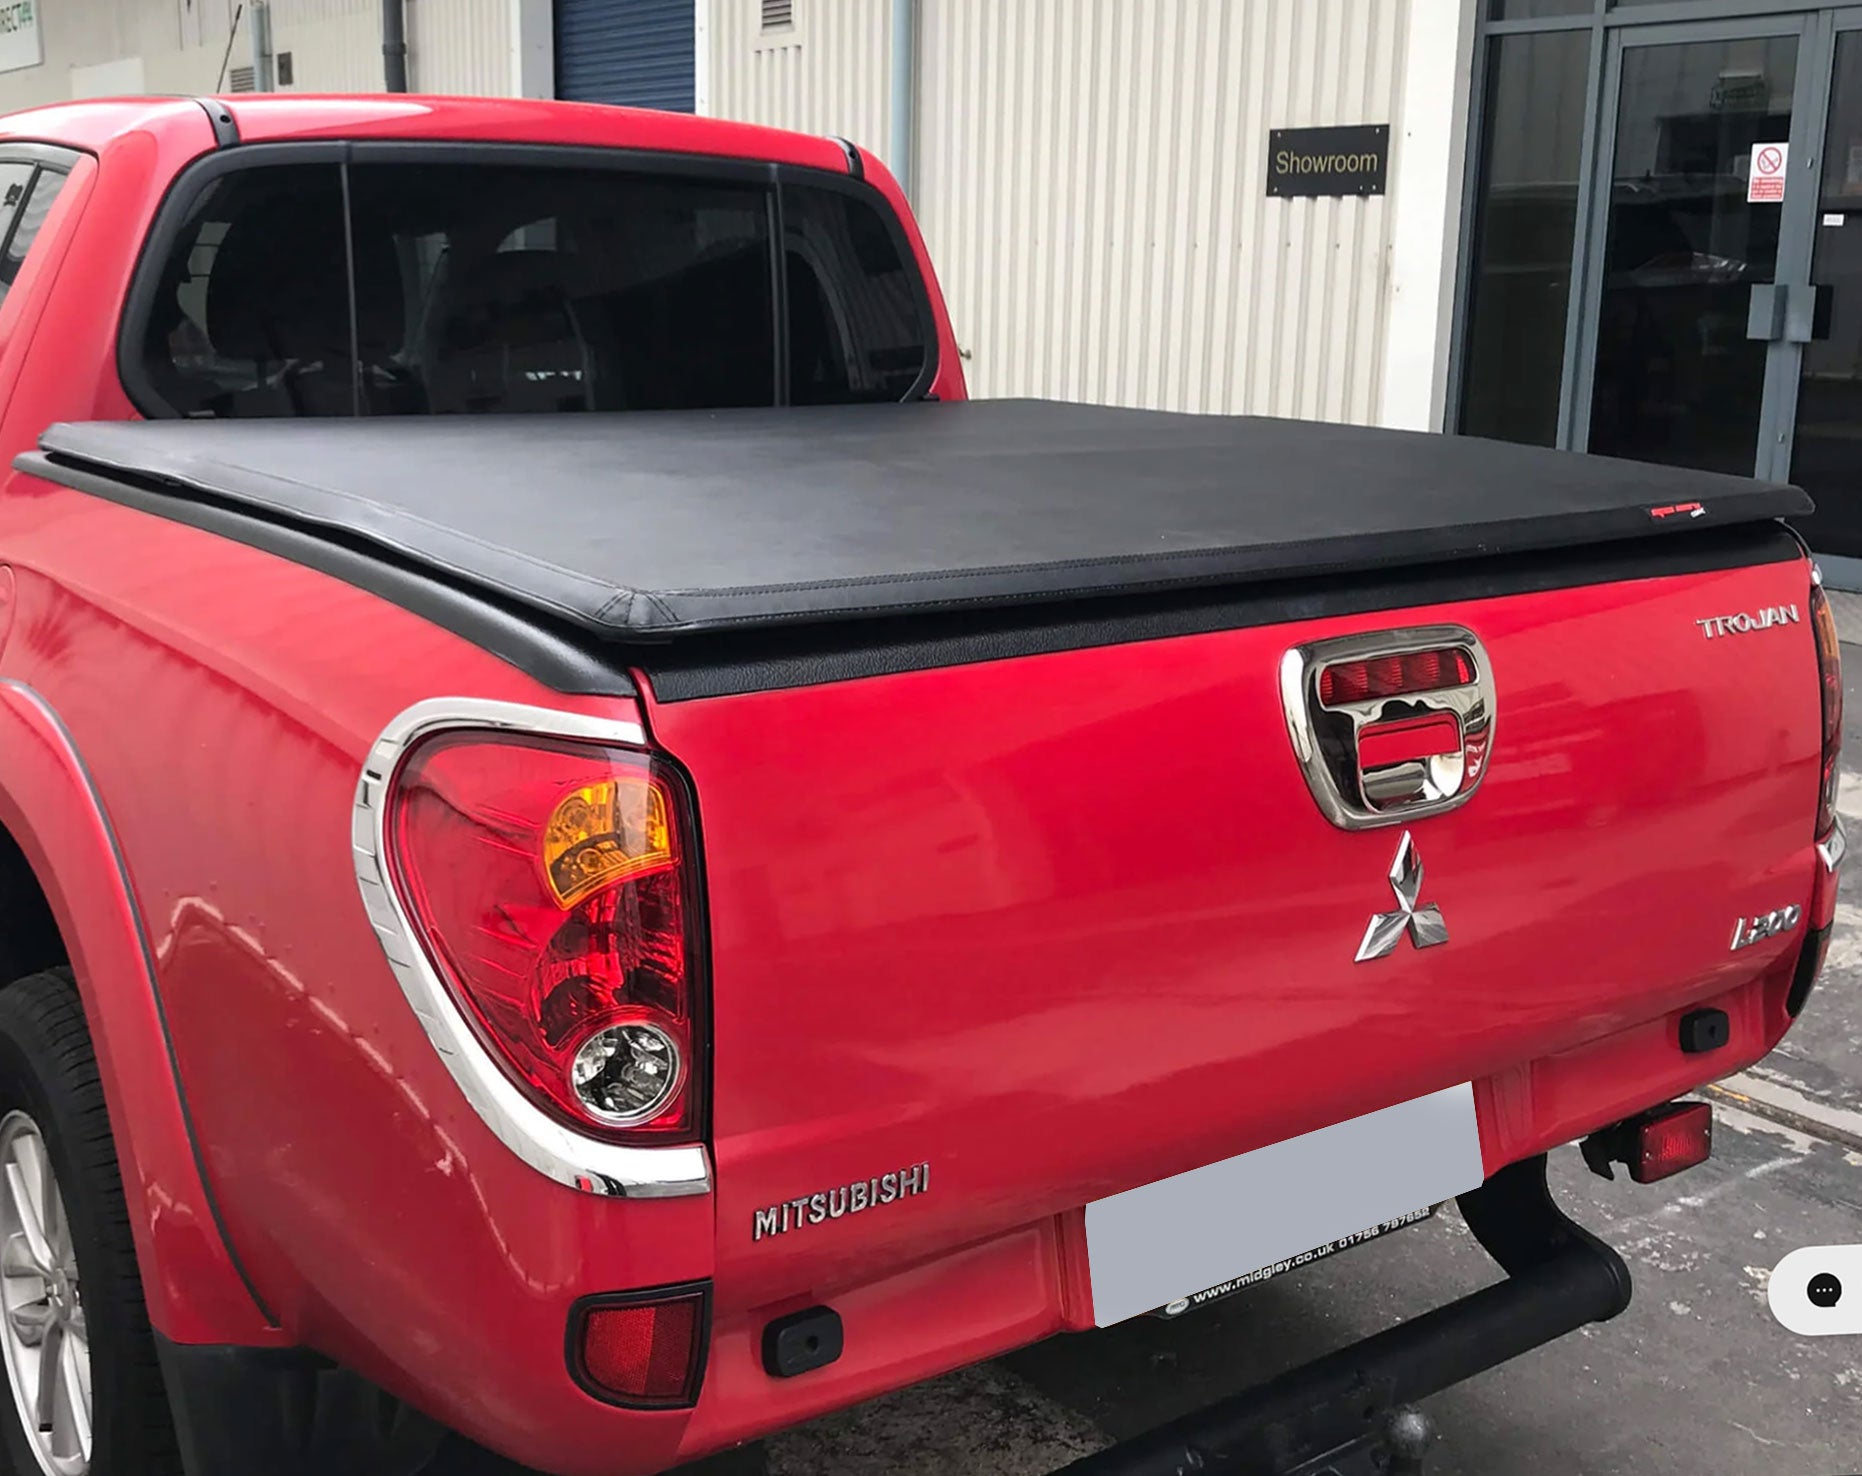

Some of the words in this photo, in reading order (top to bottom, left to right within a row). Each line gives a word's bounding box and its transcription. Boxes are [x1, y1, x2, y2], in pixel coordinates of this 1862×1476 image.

[1275, 150, 1379, 174] Showroom
[1696, 603, 1799, 638] TROJAN
[1730, 903, 1802, 951] L200
[753, 1161, 931, 1241] MITSUBISHI
[1193, 1242, 1335, 1304] www.midgley.co.uk
[1338, 1224, 1380, 1249] 01756
